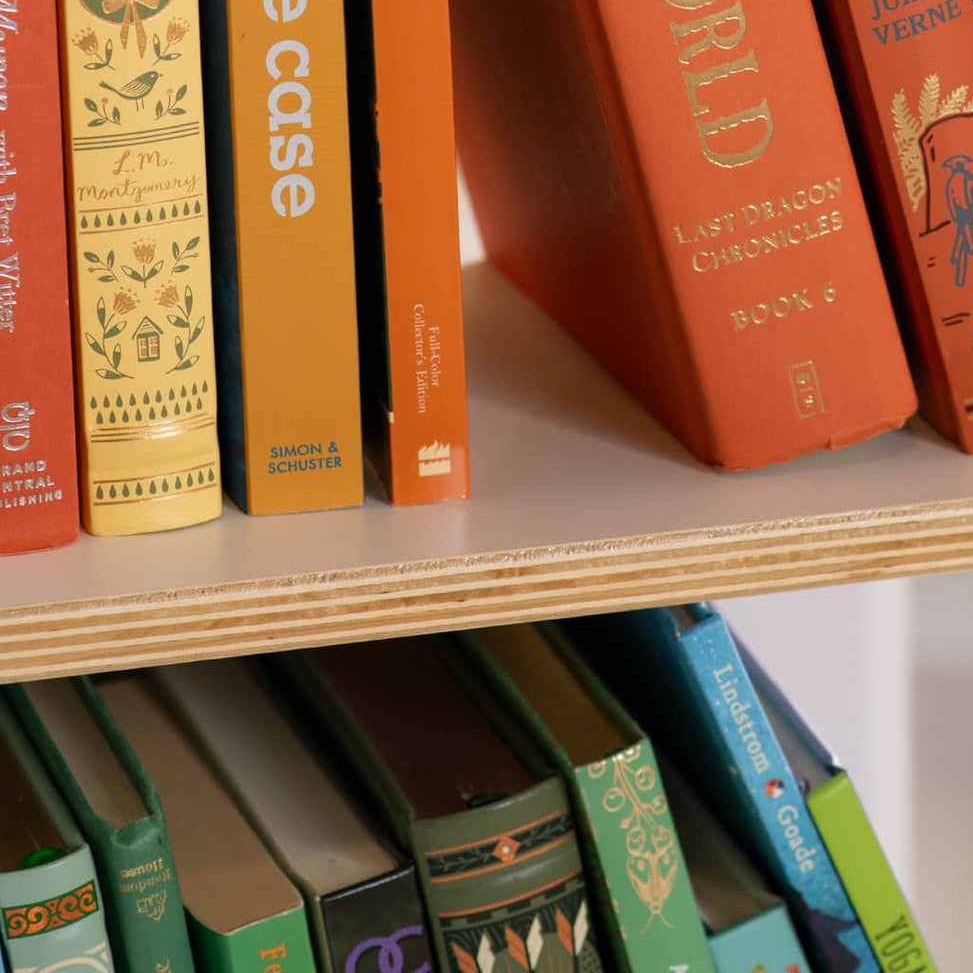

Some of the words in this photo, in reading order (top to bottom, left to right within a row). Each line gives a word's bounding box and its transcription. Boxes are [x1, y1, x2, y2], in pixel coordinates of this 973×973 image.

[265, 39, 316, 218] case
[77, 175, 199, 203] Montgomery
[673, 213, 736, 244] LAST
[742, 176, 843, 226] DRAGON
[692, 210, 844, 273] CHRONICLES
[413, 303, 427, 366] Collector's
[730, 288, 814, 331] BOOK
[823, 282, 837, 303] 6
[428, 326, 442, 388] Full-Color
[416, 370, 429, 414] Edition
[267, 456, 342, 474] SCHUSTER
[270, 443, 322, 459] SIMON
[327, 441, 338, 453] &
[0, 490, 63, 508] LISHING
[713, 662, 771, 775] Lindstrom
[776, 804, 816, 874] Goade
